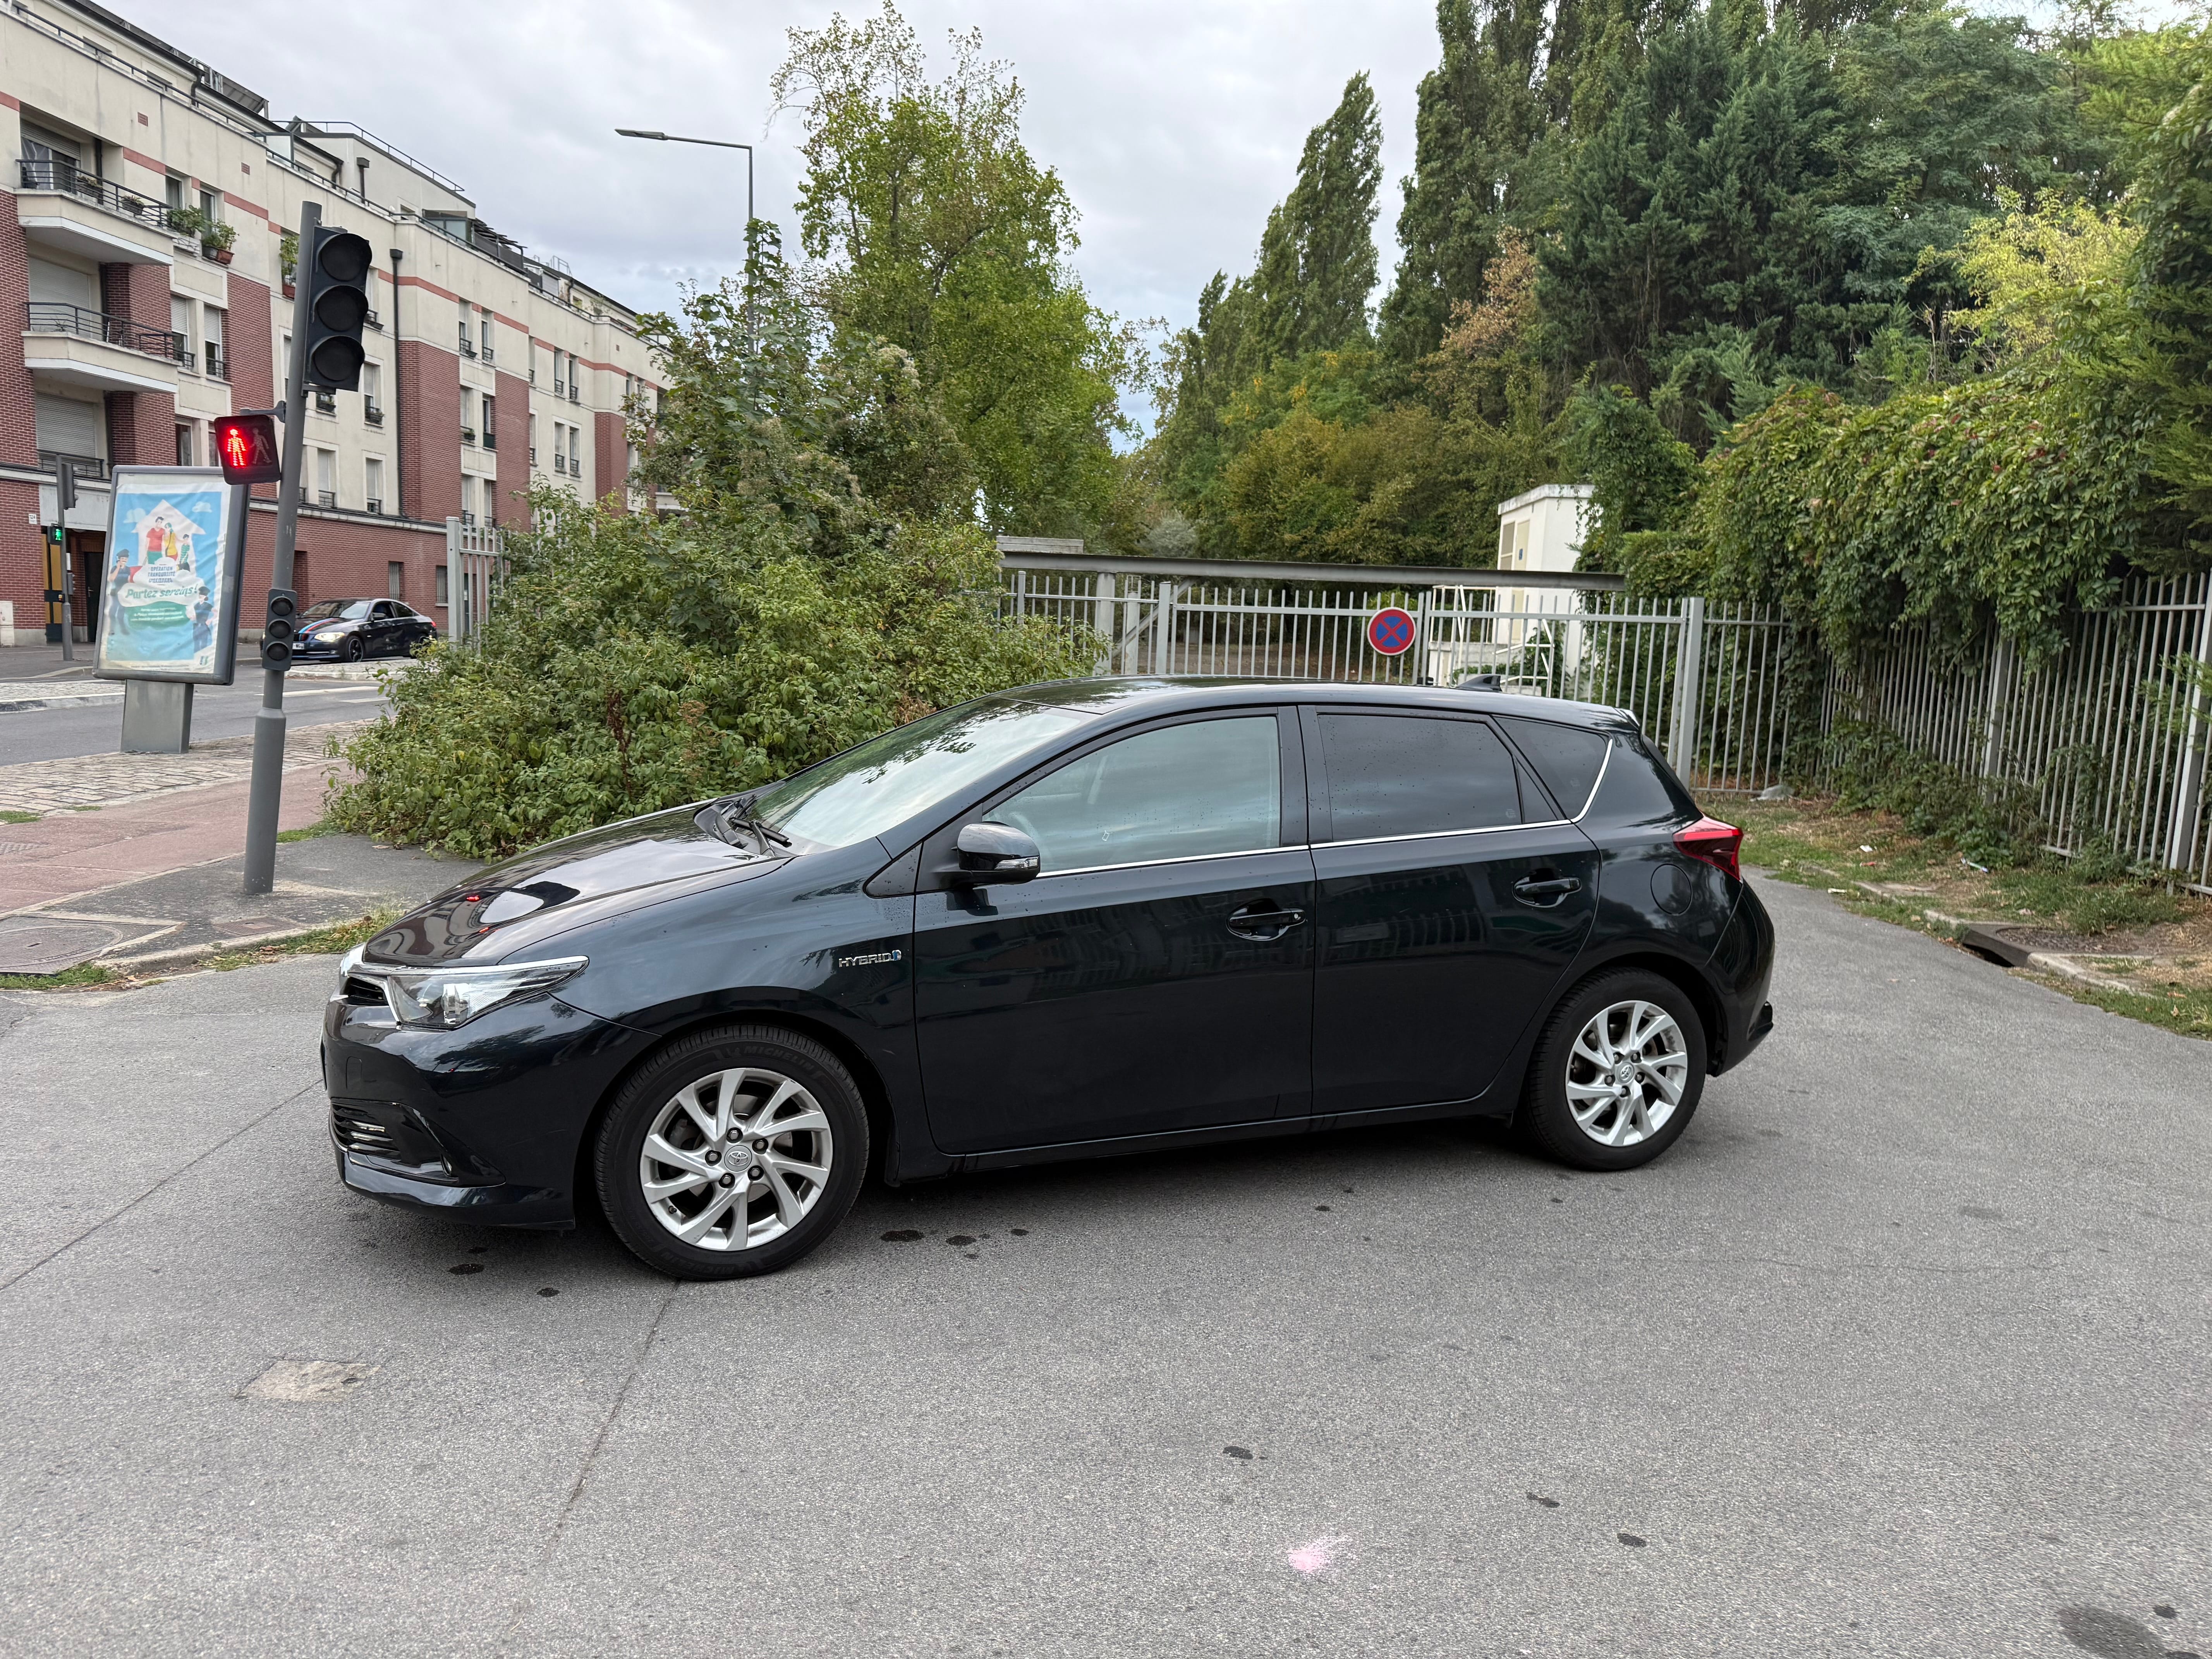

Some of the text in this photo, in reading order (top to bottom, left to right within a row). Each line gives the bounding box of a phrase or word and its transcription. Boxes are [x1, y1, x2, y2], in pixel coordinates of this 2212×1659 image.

[125, 589, 158, 599] Partez
[839, 953, 892, 967] HYBRID
[744, 1046, 815, 1070] MICHELIN
